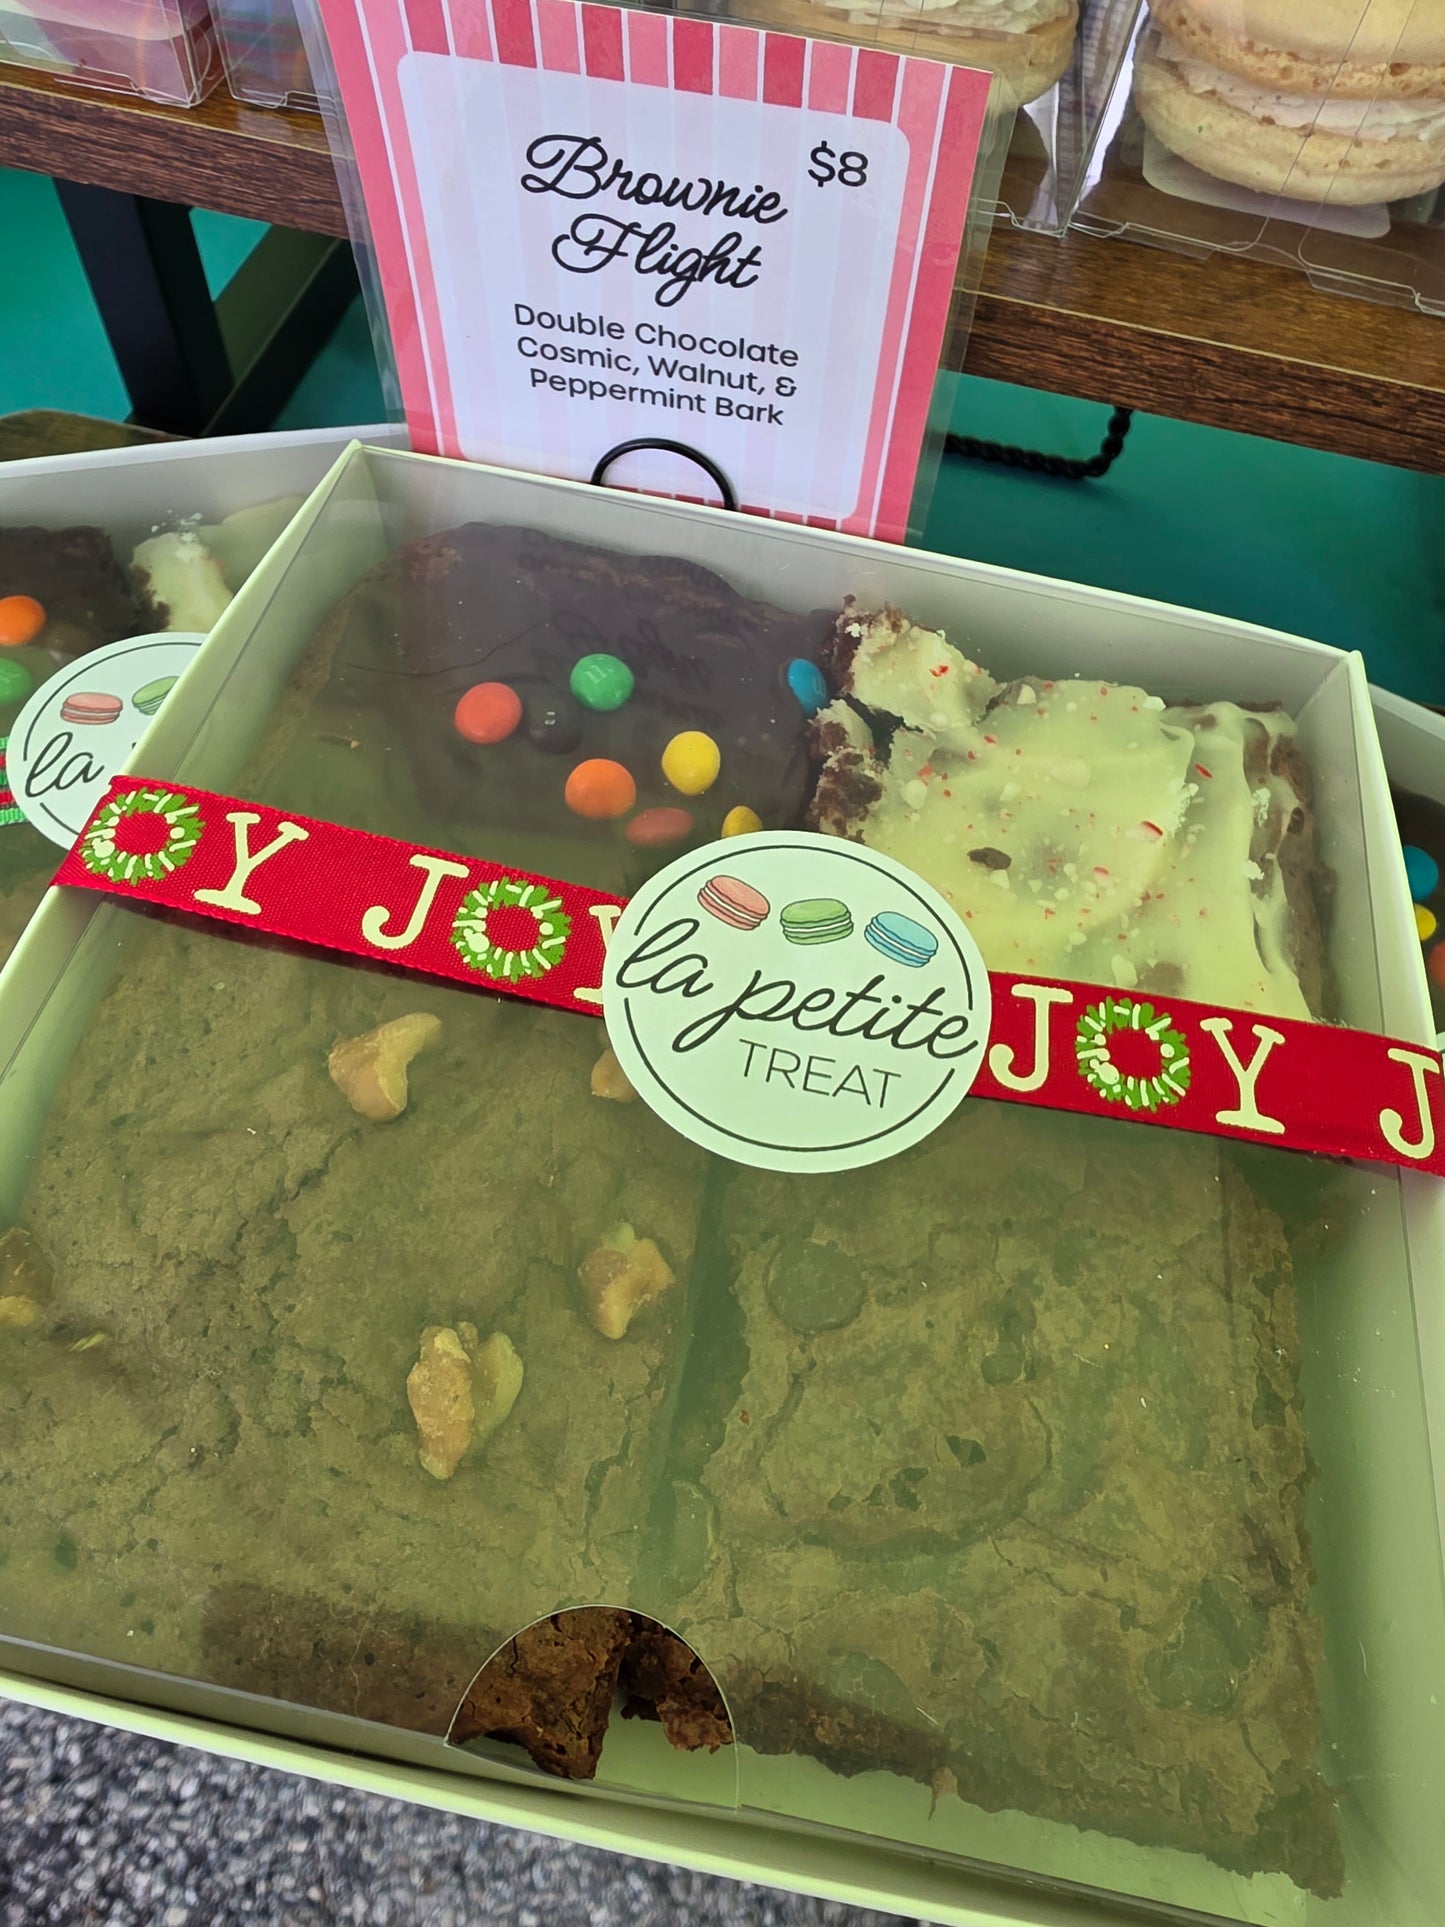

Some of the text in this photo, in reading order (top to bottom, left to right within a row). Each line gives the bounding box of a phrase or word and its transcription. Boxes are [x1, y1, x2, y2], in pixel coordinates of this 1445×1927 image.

[521, 133, 788, 224] Brownie
[808, 140, 869, 188] $8
[551, 213, 762, 308] Flight
[514, 303, 799, 368] Double Chocolate
[517, 336, 797, 398] Cosmic, Walnut, &
[530, 368, 784, 426] Peppermint Bark
[25, 731, 105, 798] la
[615, 917, 979, 1059] la petite
[738, 1038, 902, 1109] TREAT
[989, 982, 1286, 1135] JOY
